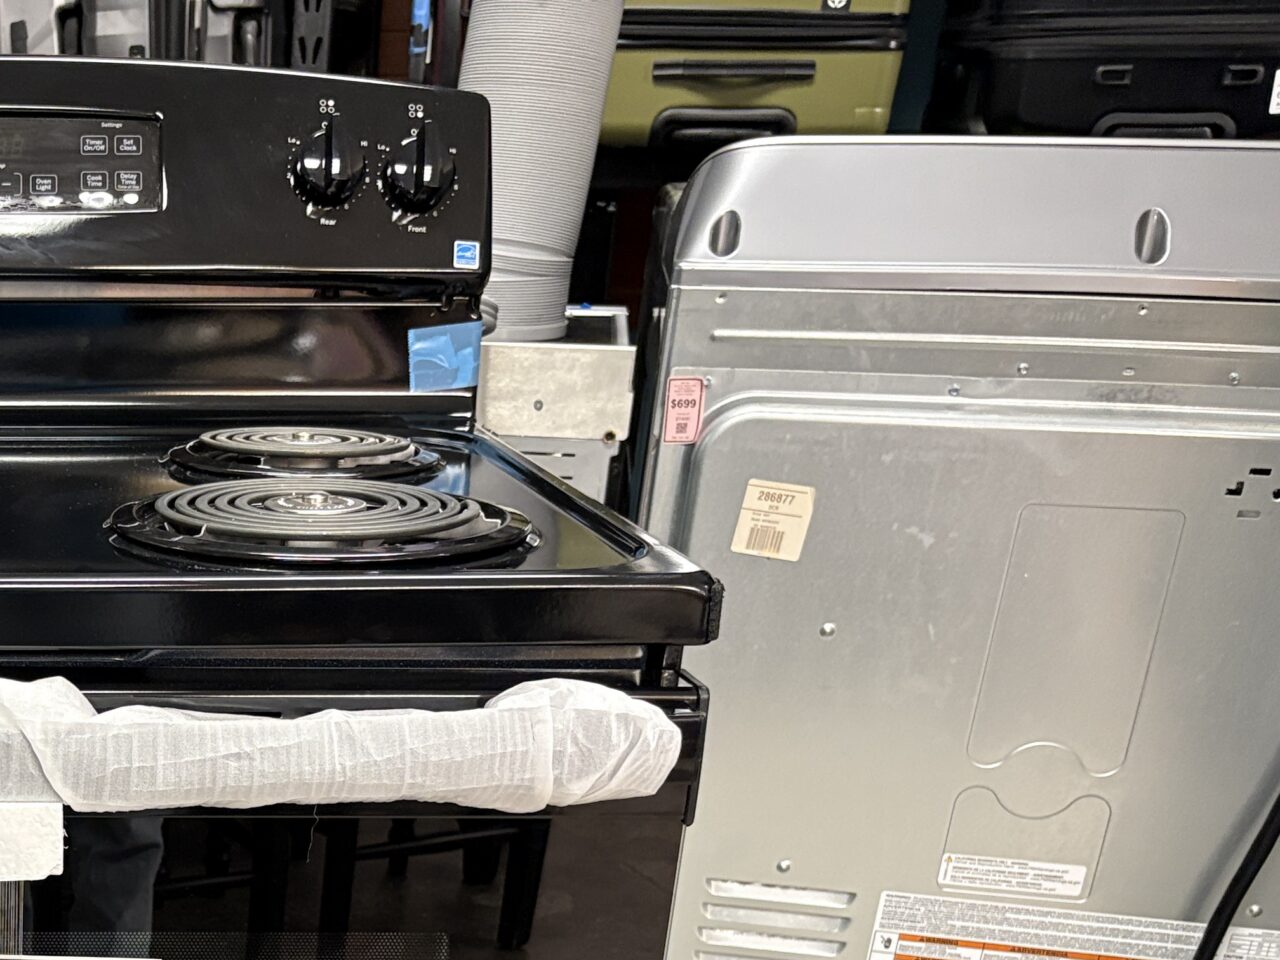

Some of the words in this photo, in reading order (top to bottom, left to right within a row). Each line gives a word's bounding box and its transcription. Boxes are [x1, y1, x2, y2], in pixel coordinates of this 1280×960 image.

[320, 217, 337, 226] Rear
[407, 225, 427, 233] Front
[670, 399, 697, 409] $699
[756, 490, 796, 506] 286877
